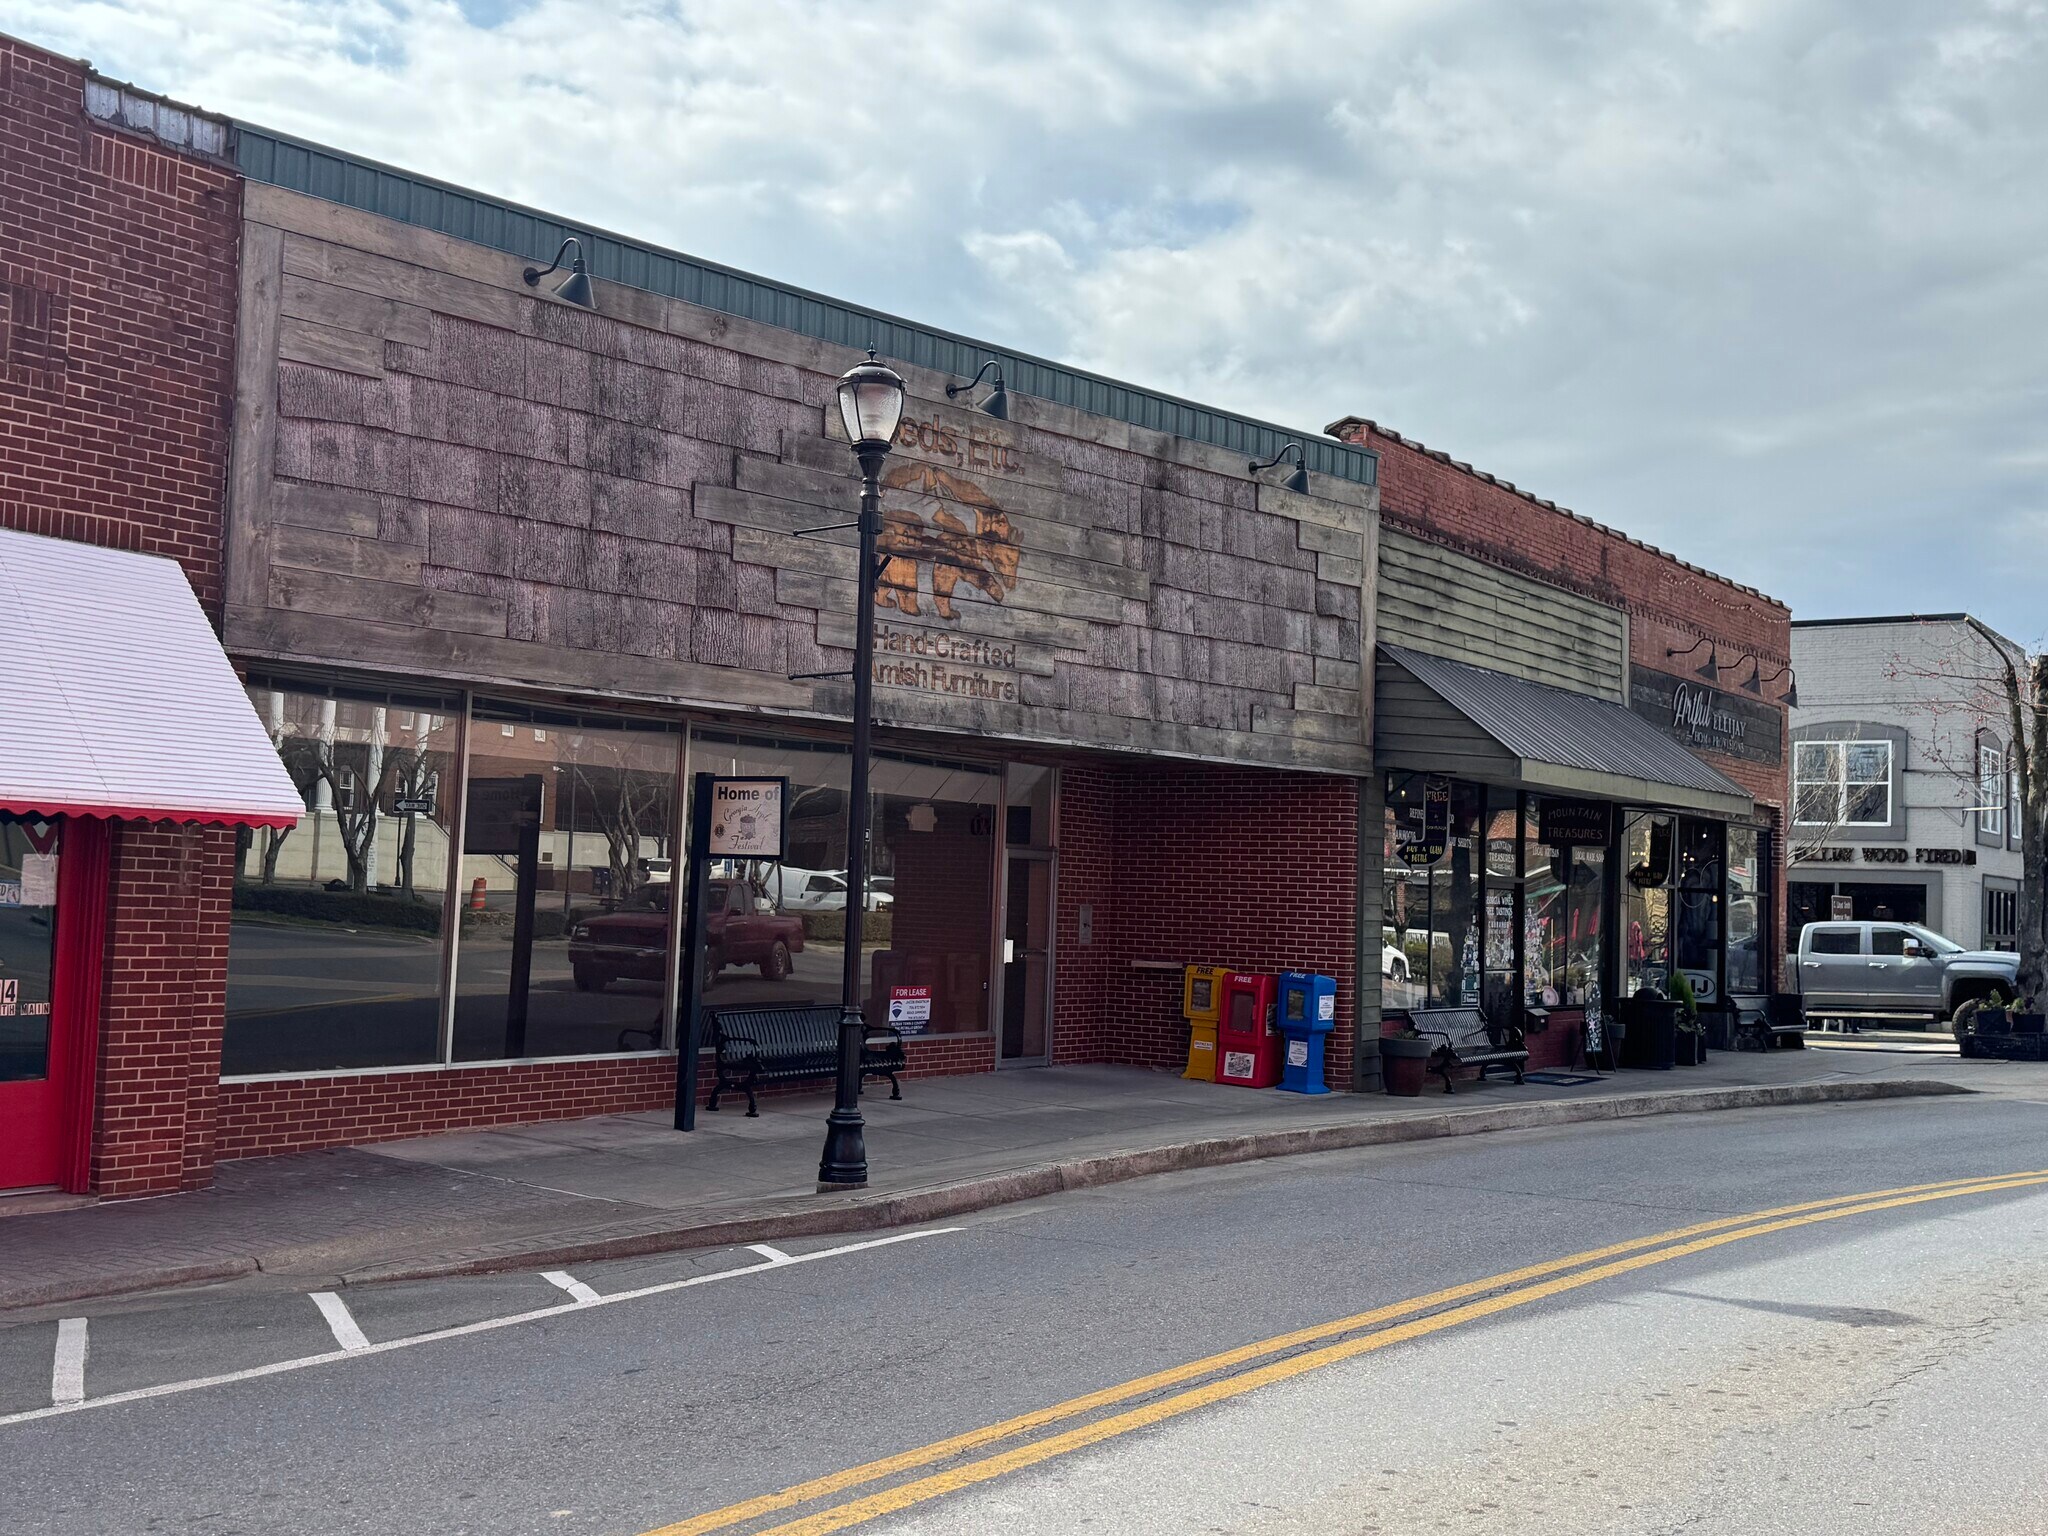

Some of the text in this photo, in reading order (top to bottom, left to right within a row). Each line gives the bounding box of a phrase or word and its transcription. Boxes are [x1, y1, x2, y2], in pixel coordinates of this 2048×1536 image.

[891, 413, 964, 467] eds,
[930, 664, 1015, 701] Furniture
[1713, 711, 1747, 739] ELLIJAY
[717, 786, 780, 800] Home of
[1426, 791, 1449, 802] FREE
[1548, 807, 1603, 821] MOUNTAIN
[1548, 827, 1604, 840] TREASURES
[728, 835, 766, 851] Festival
[1861, 847, 1908, 863] WOOD
[1196, 967, 1215, 976] FREE
[1234, 975, 1252, 984] FREE
[895, 988, 927, 997] FOR LEASE
[21, 1003, 50, 1015] MAIN
